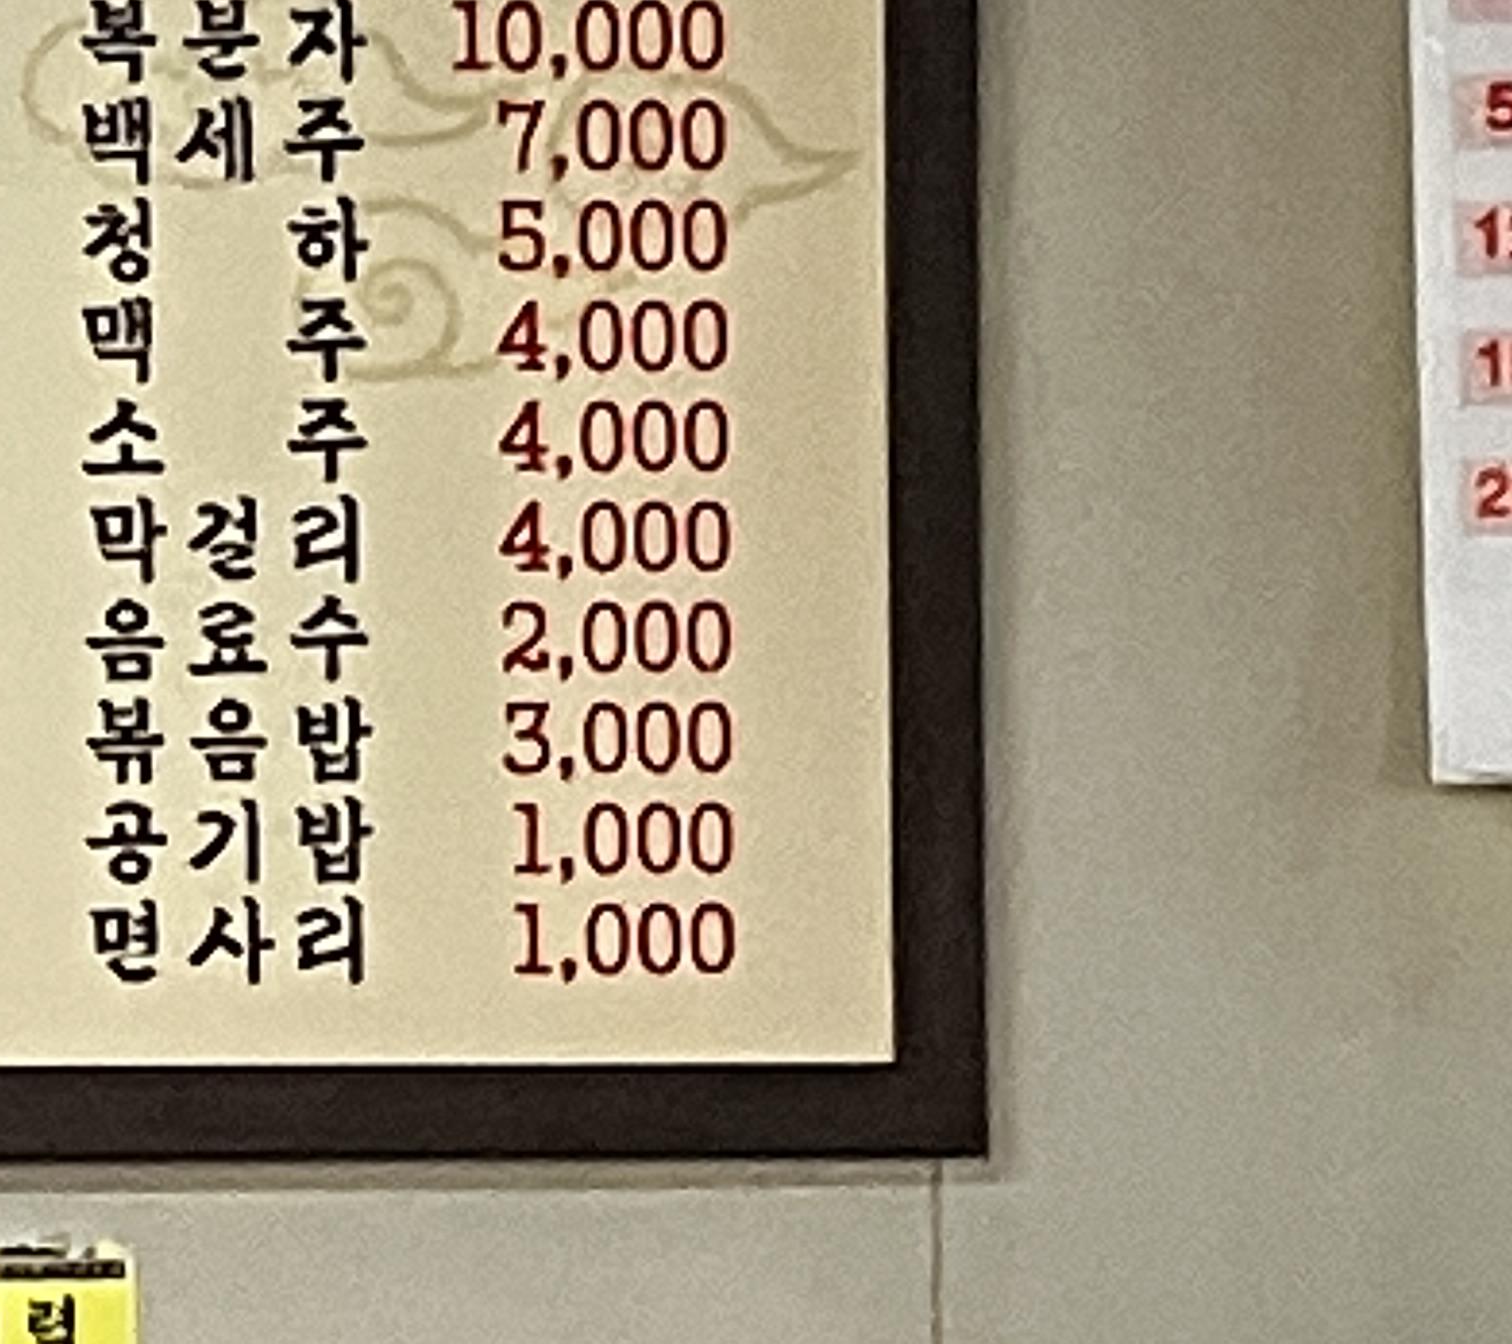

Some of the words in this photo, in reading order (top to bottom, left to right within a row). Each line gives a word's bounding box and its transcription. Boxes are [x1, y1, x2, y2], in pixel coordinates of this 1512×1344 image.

[452, 0, 724, 79] 10,000
[83, 95, 364, 185] 백세주
[498, 100, 726, 182] 7,000
[499, 200, 727, 279] 5,000
[1474, 207, 1512, 259] 1
[497, 300, 727, 381] 4,000
[499, 400, 727, 480] 4,000
[90, 494, 358, 584] 막걸리
[499, 501, 730, 580] 4,000
[86, 595, 369, 683] 음료수
[503, 601, 731, 681] 2,000
[86, 695, 373, 784] 볶음밥
[503, 702, 731, 782] 3,000
[85, 796, 373, 884] 공기밥
[514, 803, 733, 884] 1,000
[89, 895, 363, 985] 면사리
[515, 903, 734, 984] 1,000
